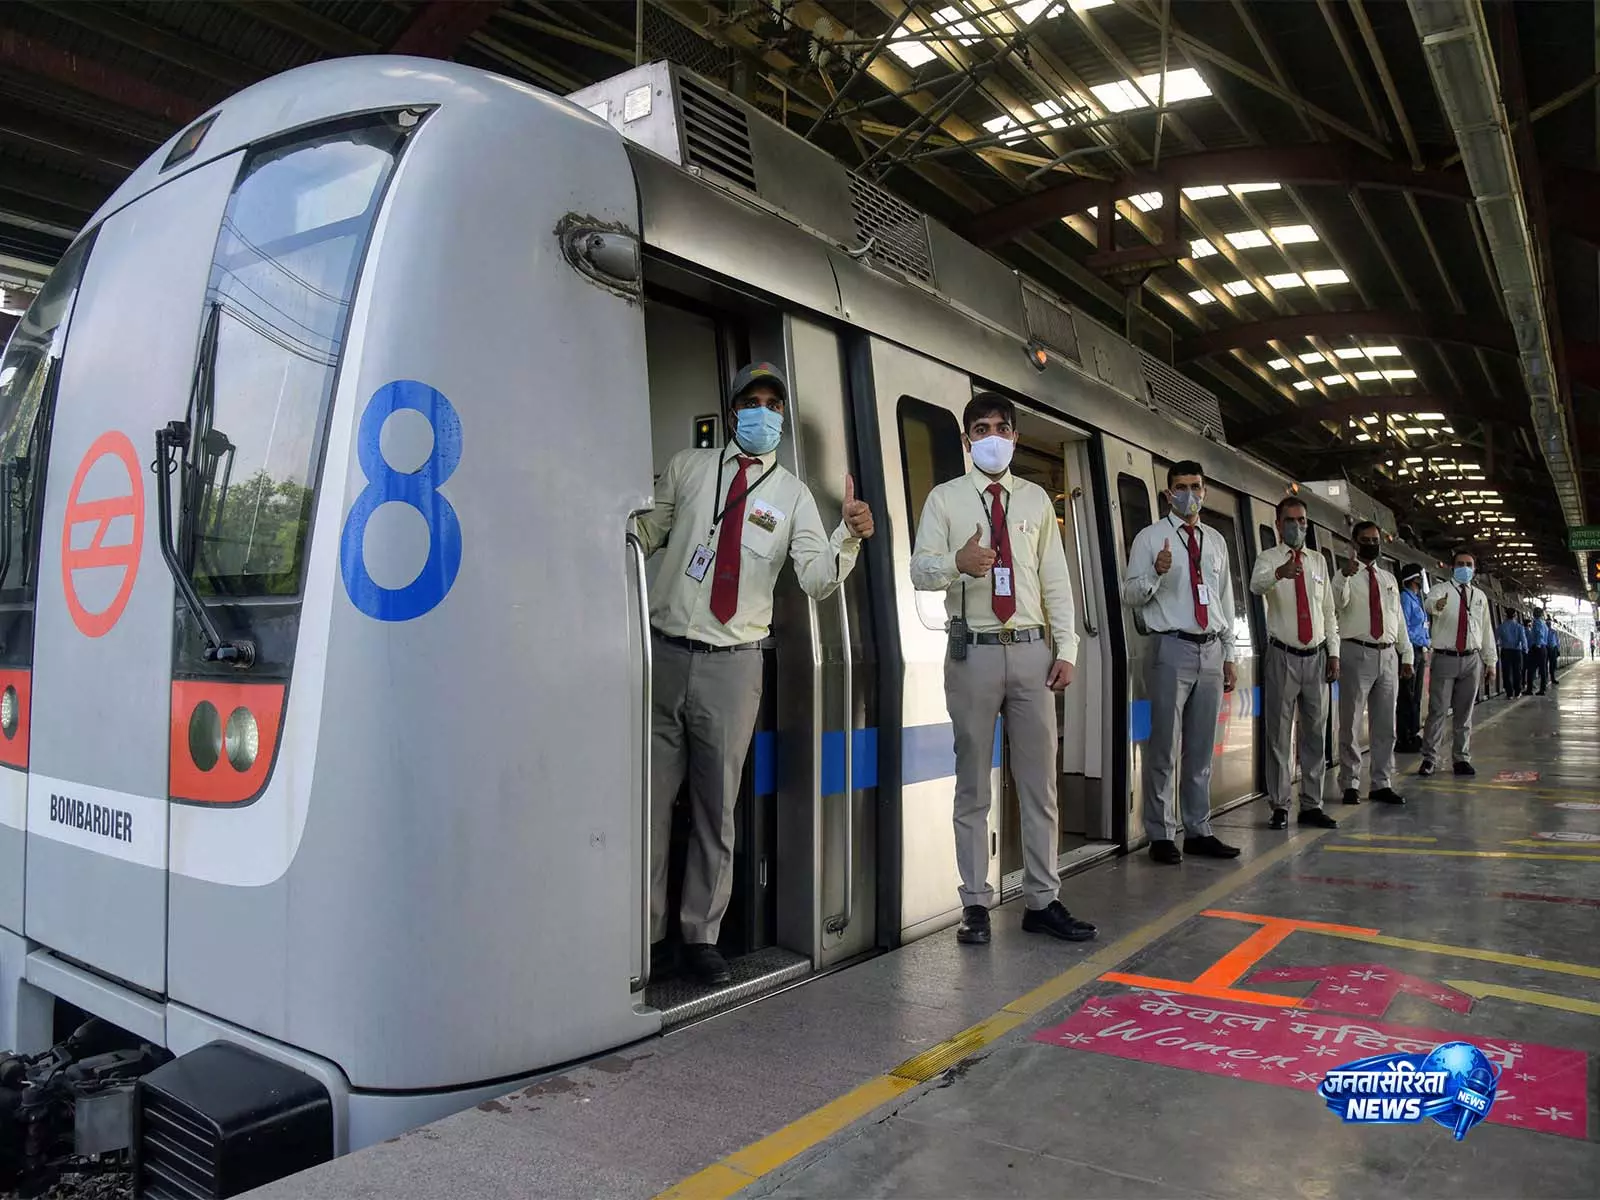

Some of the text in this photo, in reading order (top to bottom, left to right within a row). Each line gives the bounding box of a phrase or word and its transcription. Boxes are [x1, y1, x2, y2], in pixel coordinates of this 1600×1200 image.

[341, 379, 463, 622] 8
[50, 793, 133, 843] BOMBARDIER
[1139, 996, 1276, 1032] केवल
[1096, 1019, 1298, 1069] Women
